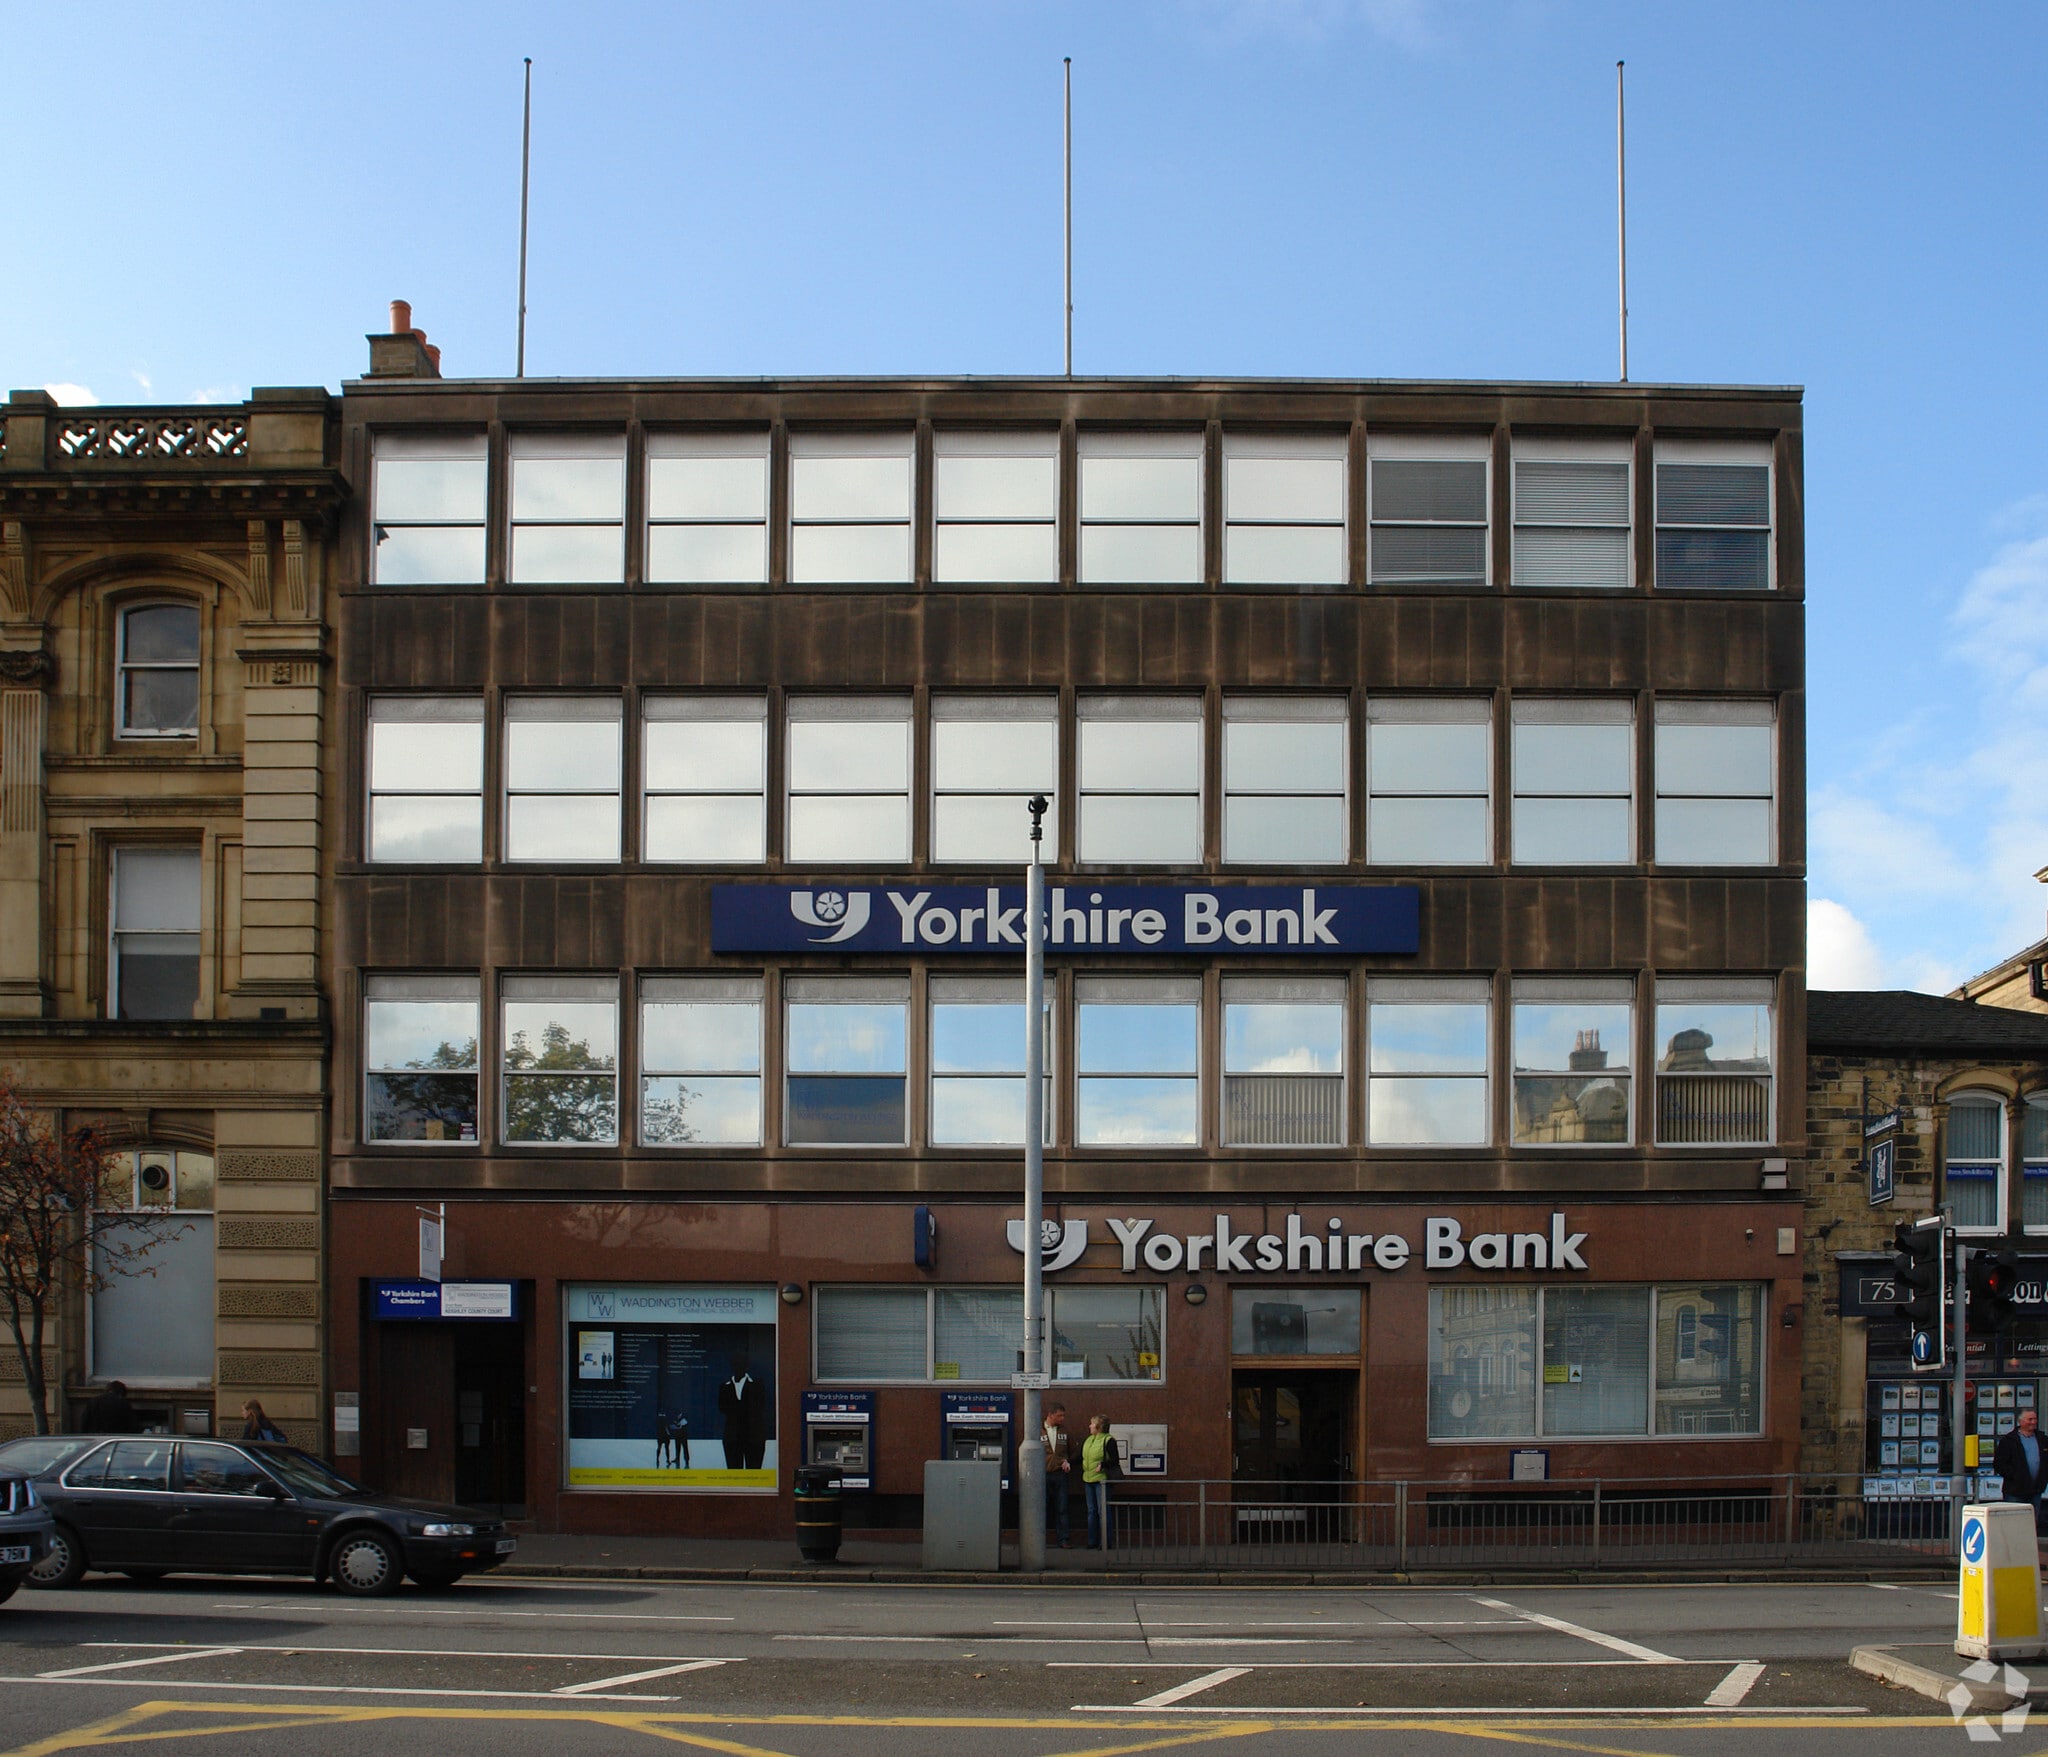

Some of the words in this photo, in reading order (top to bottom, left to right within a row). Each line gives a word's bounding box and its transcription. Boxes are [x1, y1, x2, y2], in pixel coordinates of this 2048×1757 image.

[1184, 888, 1339, 945] Bank
[1106, 1213, 1409, 1273] Yorkshire
[1426, 1212, 1589, 1271] Bank
[391, 1290, 420, 1298] Yorkshire
[421, 1290, 438, 1298] Bank
[1872, 1282, 1895, 1301] 75
[591, 1294, 605, 1306] W
[620, 1297, 700, 1309] WADDINGTON
[703, 1298, 754, 1309] WEBBER
[598, 1305, 613, 1317] W
